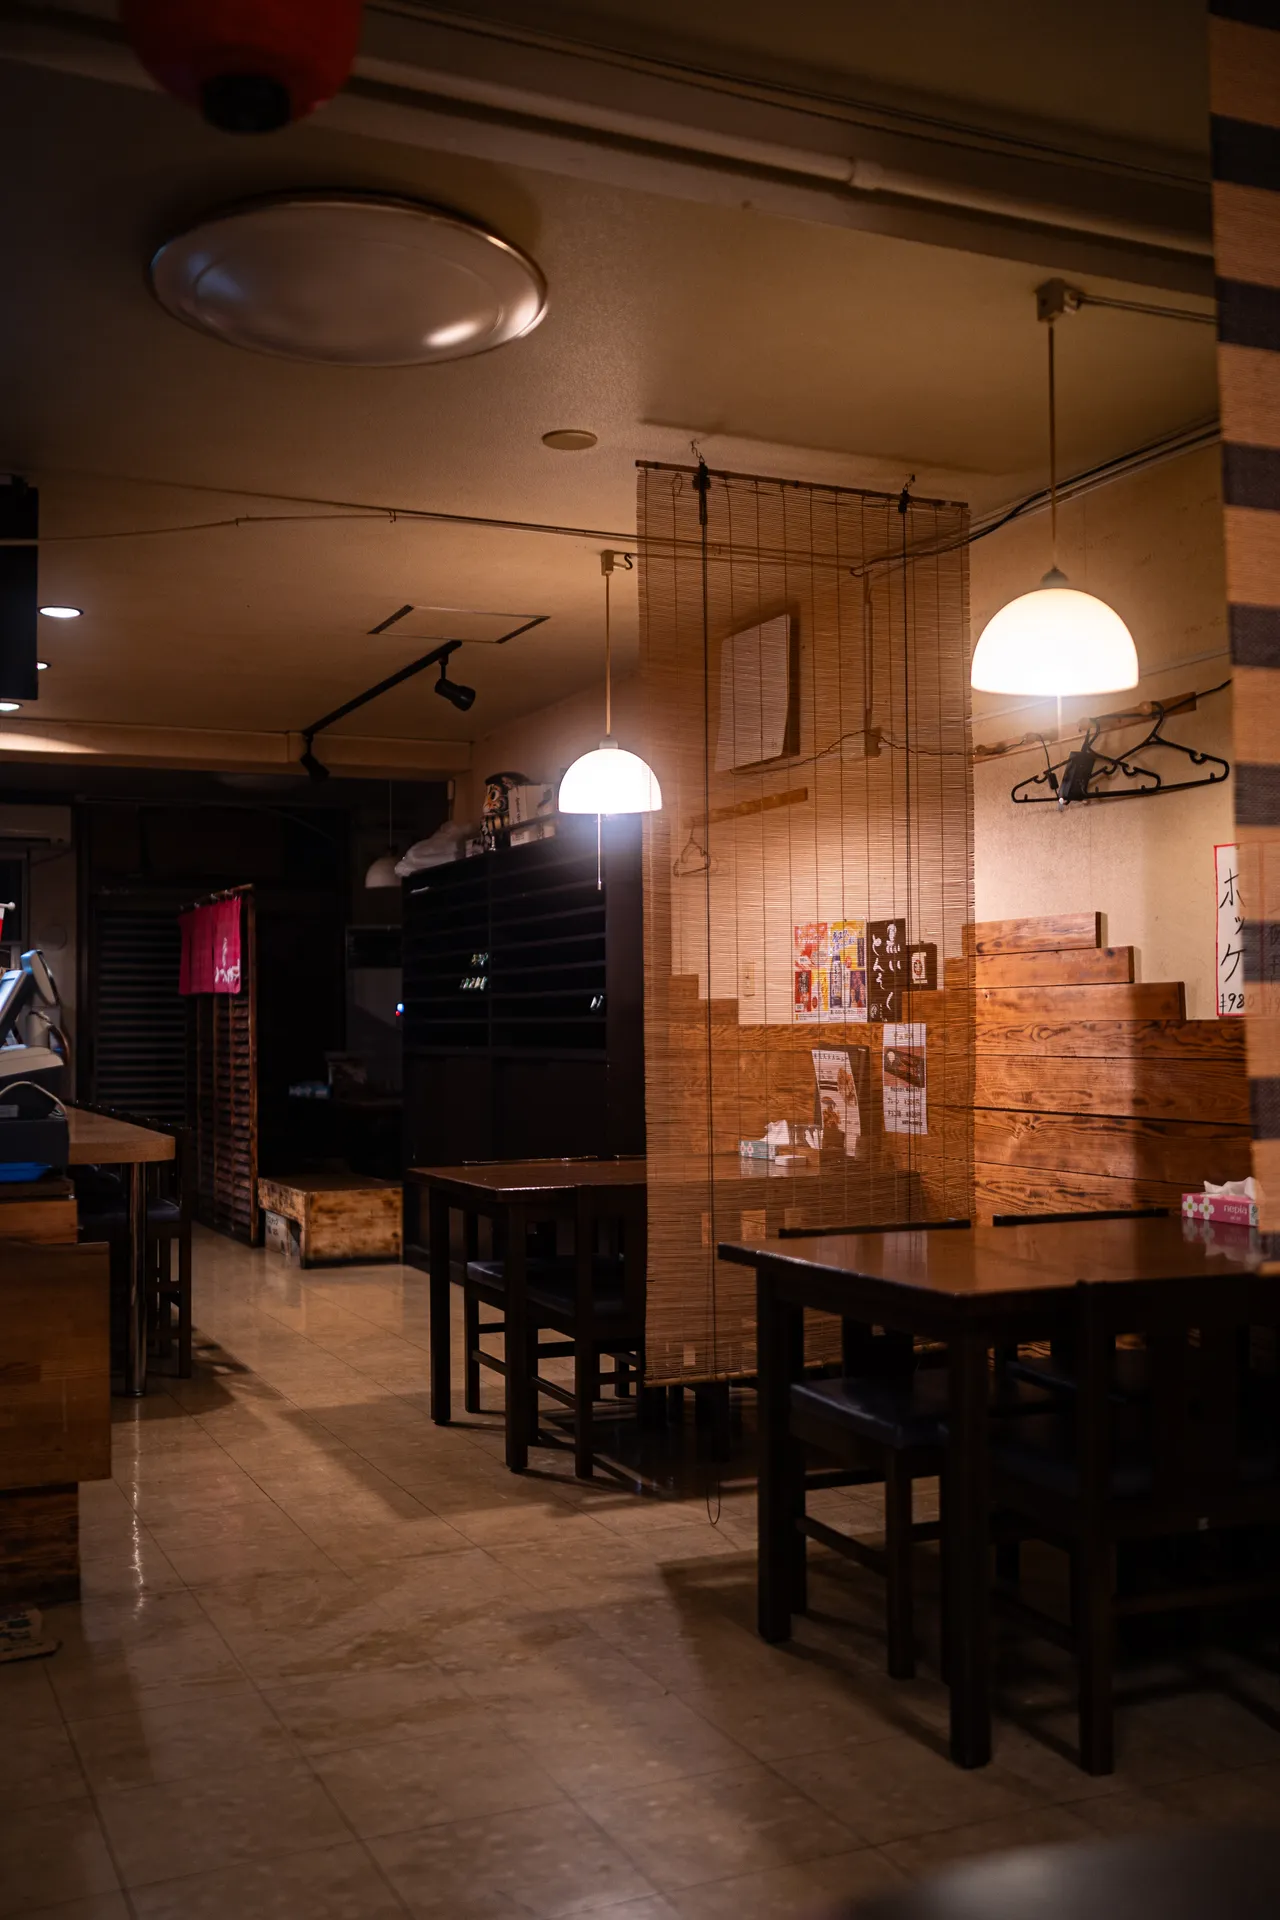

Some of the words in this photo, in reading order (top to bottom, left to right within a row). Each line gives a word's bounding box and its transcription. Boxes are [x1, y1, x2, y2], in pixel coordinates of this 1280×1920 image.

[1219, 868, 1246, 983] ホッケ
[1223, 1203, 1248, 1216] nepia
